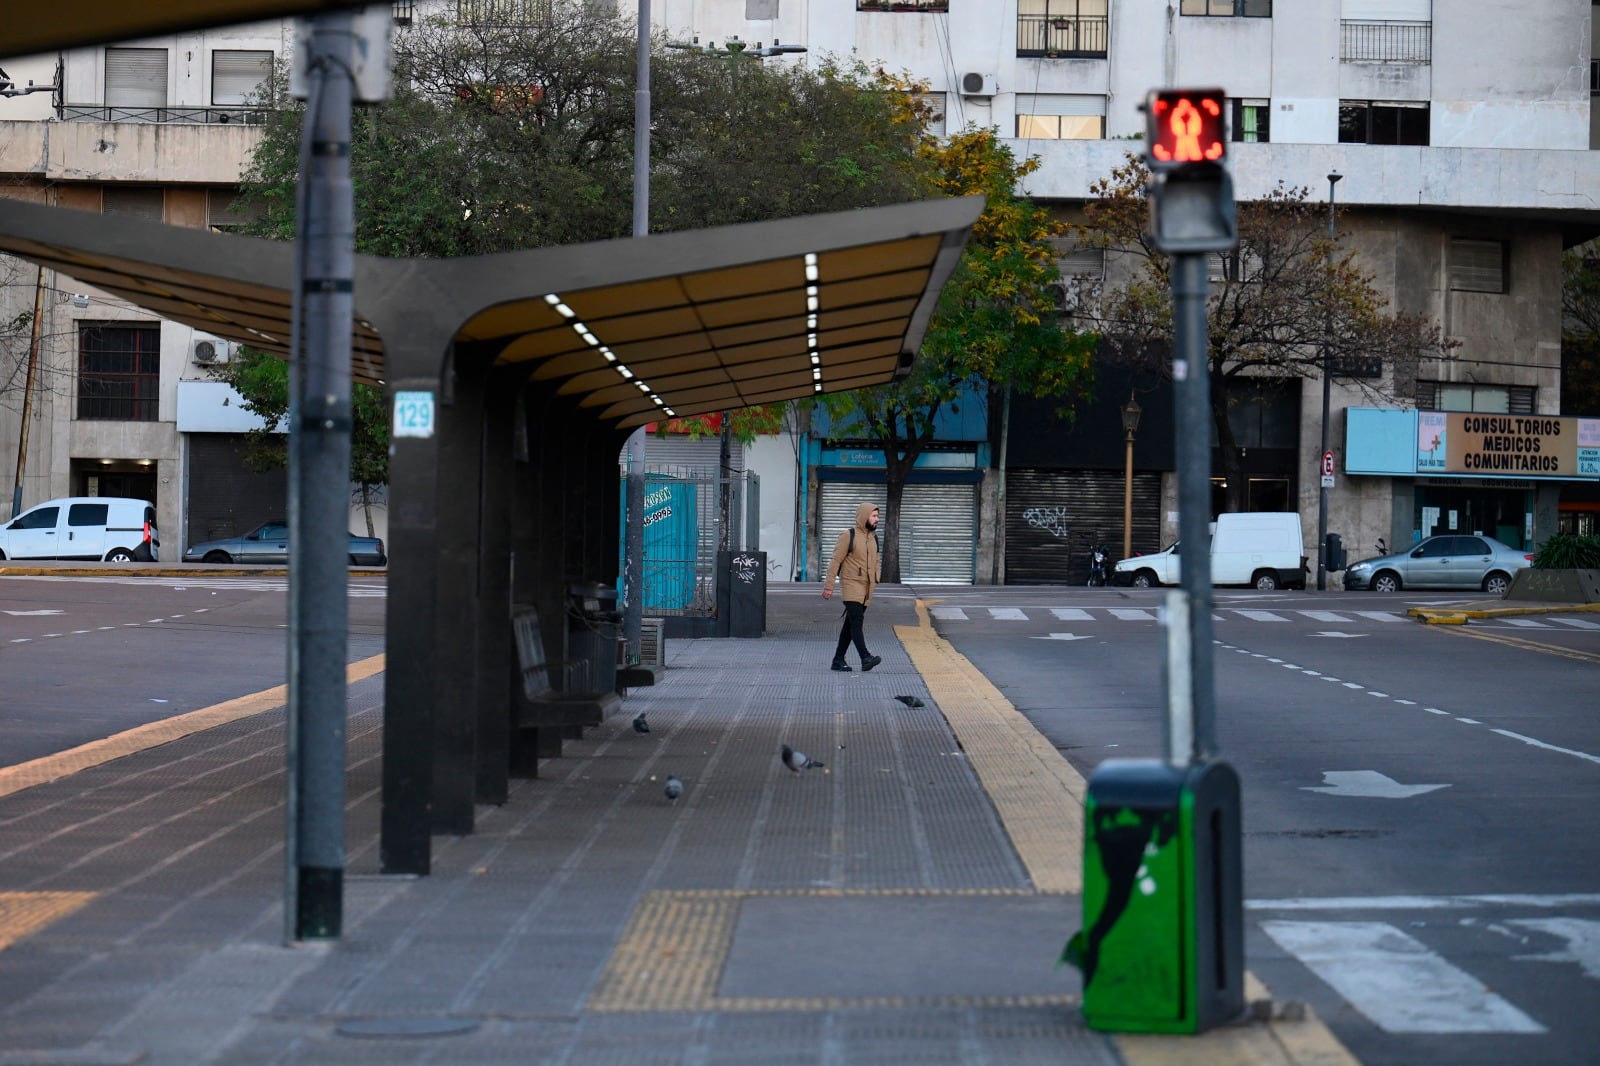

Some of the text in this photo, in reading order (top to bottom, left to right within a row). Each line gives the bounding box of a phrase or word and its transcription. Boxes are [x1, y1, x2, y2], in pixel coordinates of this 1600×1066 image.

[399, 403, 430, 428] 129
[1464, 417, 1560, 436] CONSULTORIOS
[1483, 436, 1541, 453] MEDICOS
[1464, 453, 1558, 471] COMUNITARIOS
